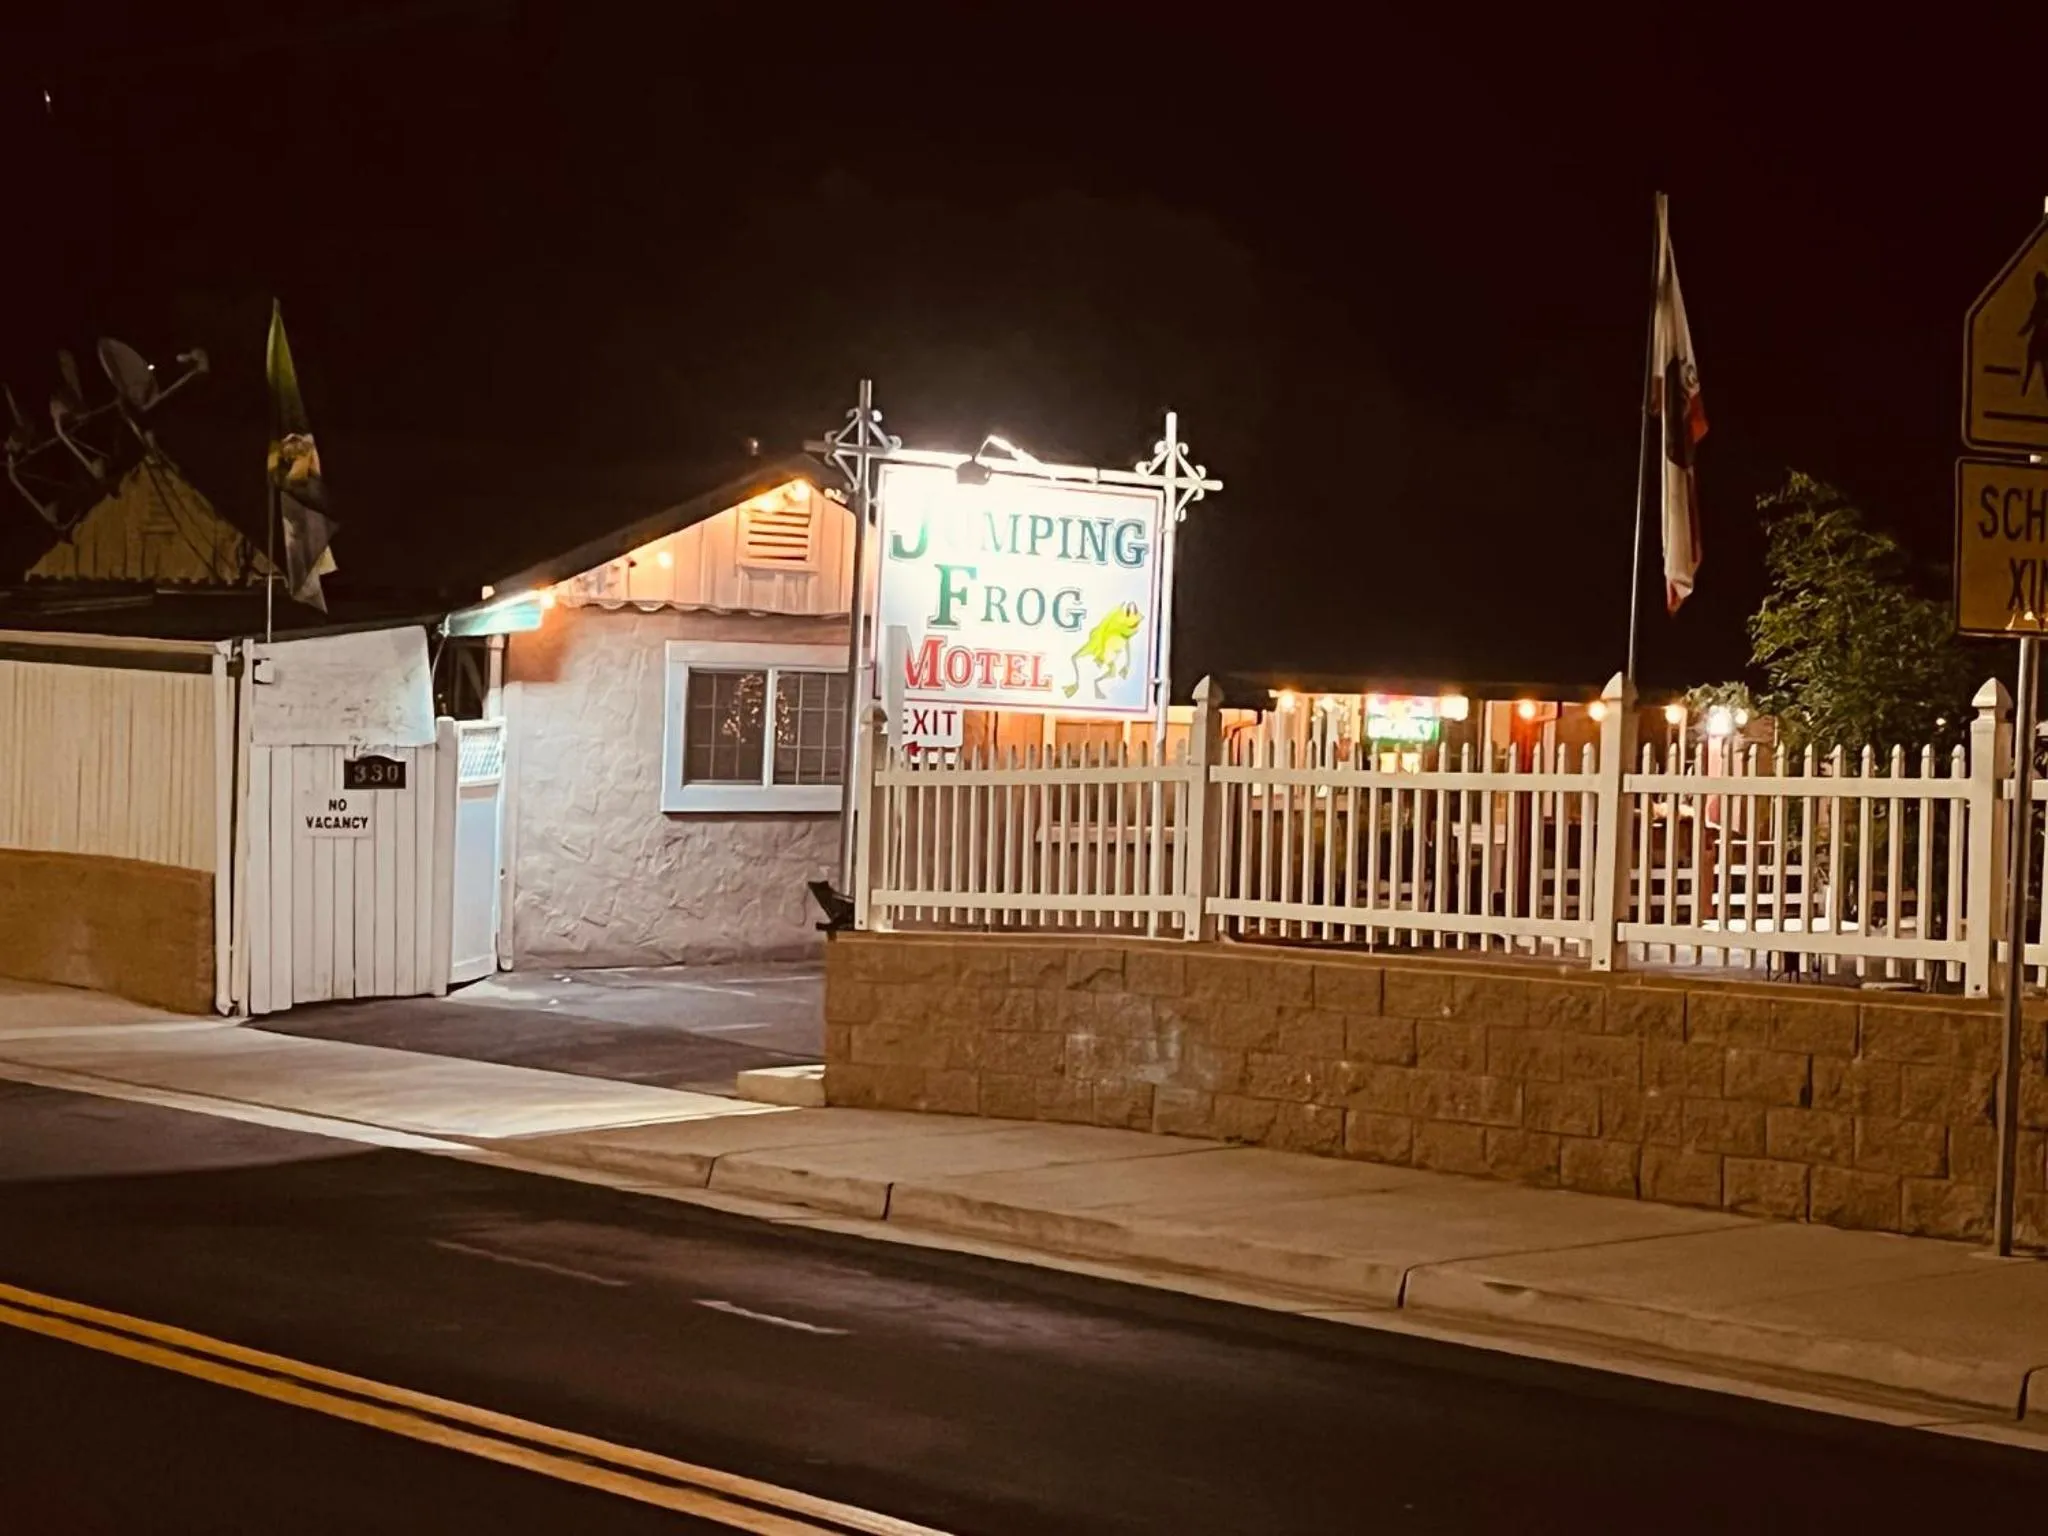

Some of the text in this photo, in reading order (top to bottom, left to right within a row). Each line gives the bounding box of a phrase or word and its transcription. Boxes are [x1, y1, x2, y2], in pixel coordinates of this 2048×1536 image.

[889, 500, 1150, 568] JMPING
[927, 563, 1087, 632] FROG
[903, 634, 1052, 692] MOTEL
[353, 764, 399, 783] 330
[306, 816, 369, 830] VACANCY
[328, 798, 347, 811] NO
